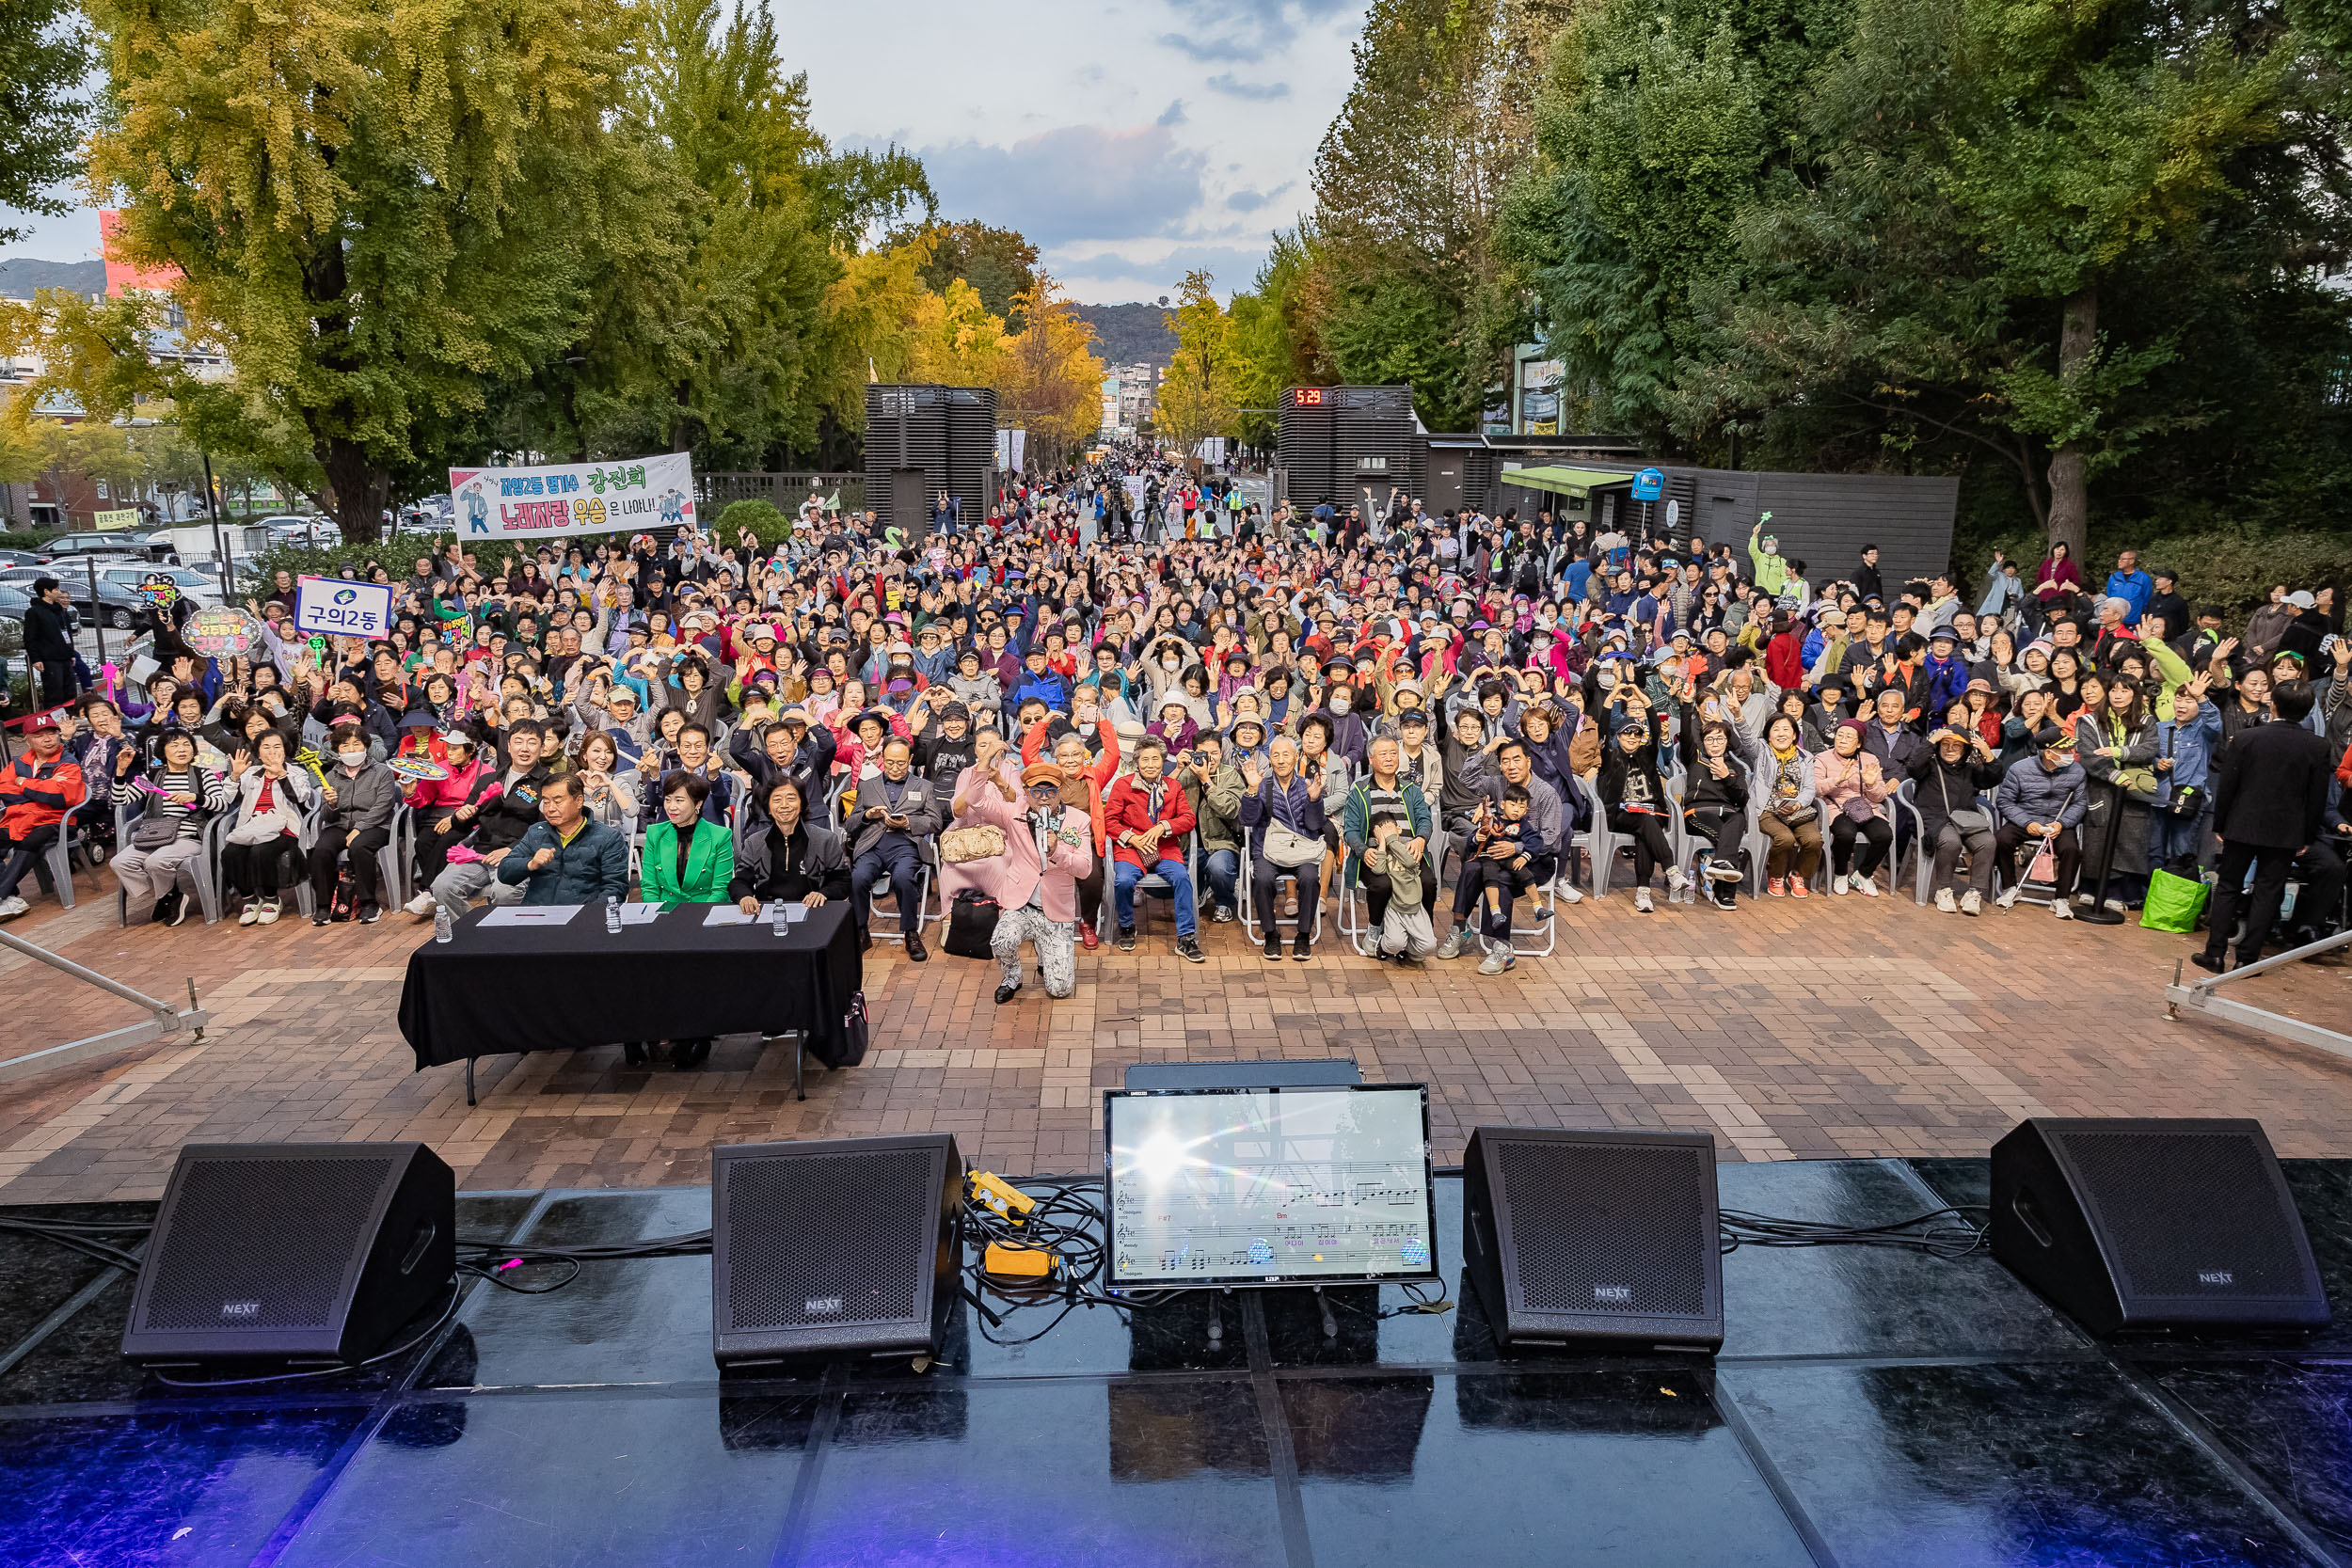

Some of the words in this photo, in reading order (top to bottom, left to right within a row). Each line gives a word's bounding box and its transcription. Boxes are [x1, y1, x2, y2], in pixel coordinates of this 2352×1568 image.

[500, 477, 544, 497] 자양2동
[546, 474, 580, 494] 명가수
[587, 465, 646, 495] 강진희
[500, 499, 569, 531] 노래자랑
[573, 497, 607, 526] 우승
[610, 500, 620, 516] 은
[622, 498, 656, 515] 나야나!
[307, 606, 378, 631] 구의2동
[195, 635, 248, 652] 구의2동
[37, 717, 47, 726] N
[2199, 1271, 2233, 1285] NEXT
[1595, 1286, 1630, 1300] NEXT
[223, 1302, 259, 1317] NEXT
[805, 1297, 841, 1311] NEXT
